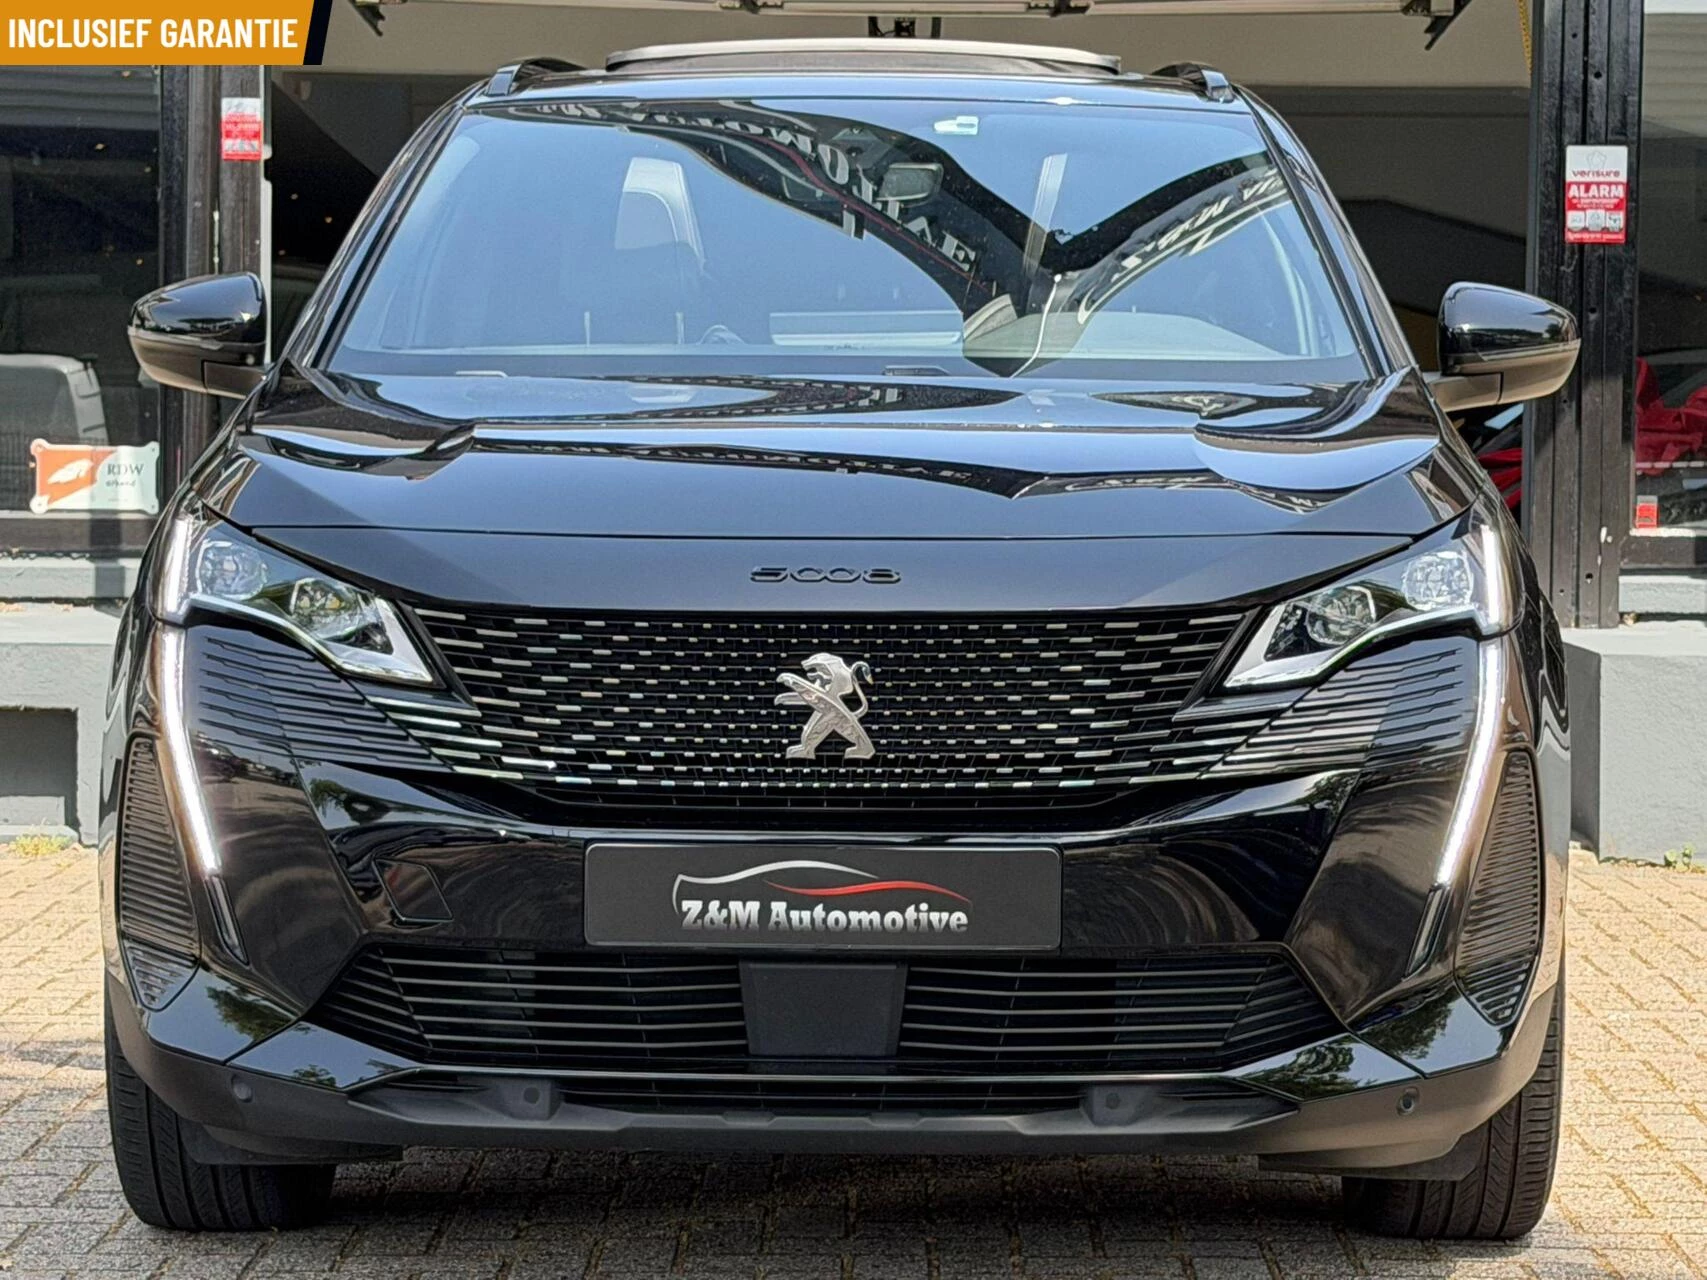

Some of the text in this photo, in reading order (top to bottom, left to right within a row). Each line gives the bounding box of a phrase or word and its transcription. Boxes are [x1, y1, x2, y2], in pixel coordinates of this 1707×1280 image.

[1572, 169, 1621, 178] verisure
[1568, 184, 1625, 198] ALARM
[107, 463, 145, 476] RDW
[750, 566, 902, 585] 5008
[681, 900, 969, 933] Z&M Automotive
